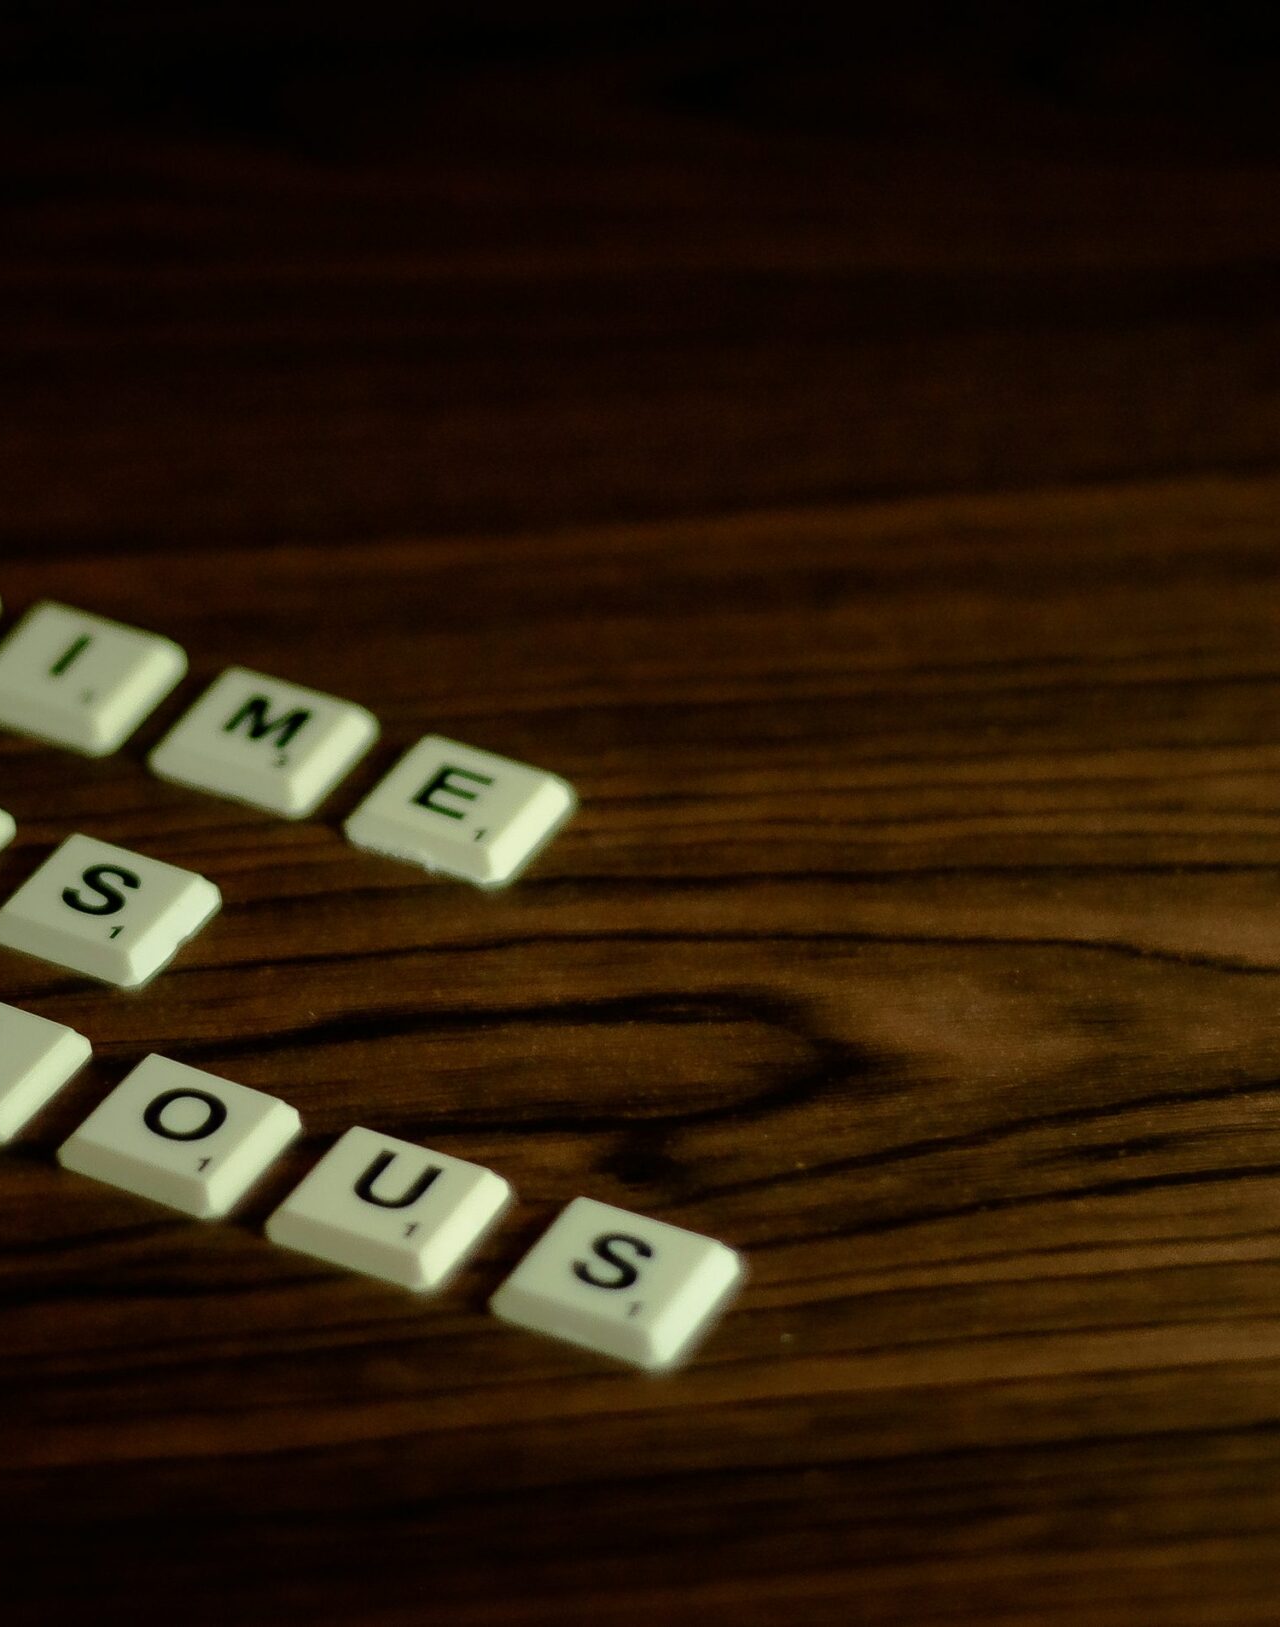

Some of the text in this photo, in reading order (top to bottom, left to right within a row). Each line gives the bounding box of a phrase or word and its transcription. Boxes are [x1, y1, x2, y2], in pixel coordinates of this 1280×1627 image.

[110, 926, 124, 940] 1
[198, 1158, 212, 1173] 1
[405, 1223, 419, 1238] 1
